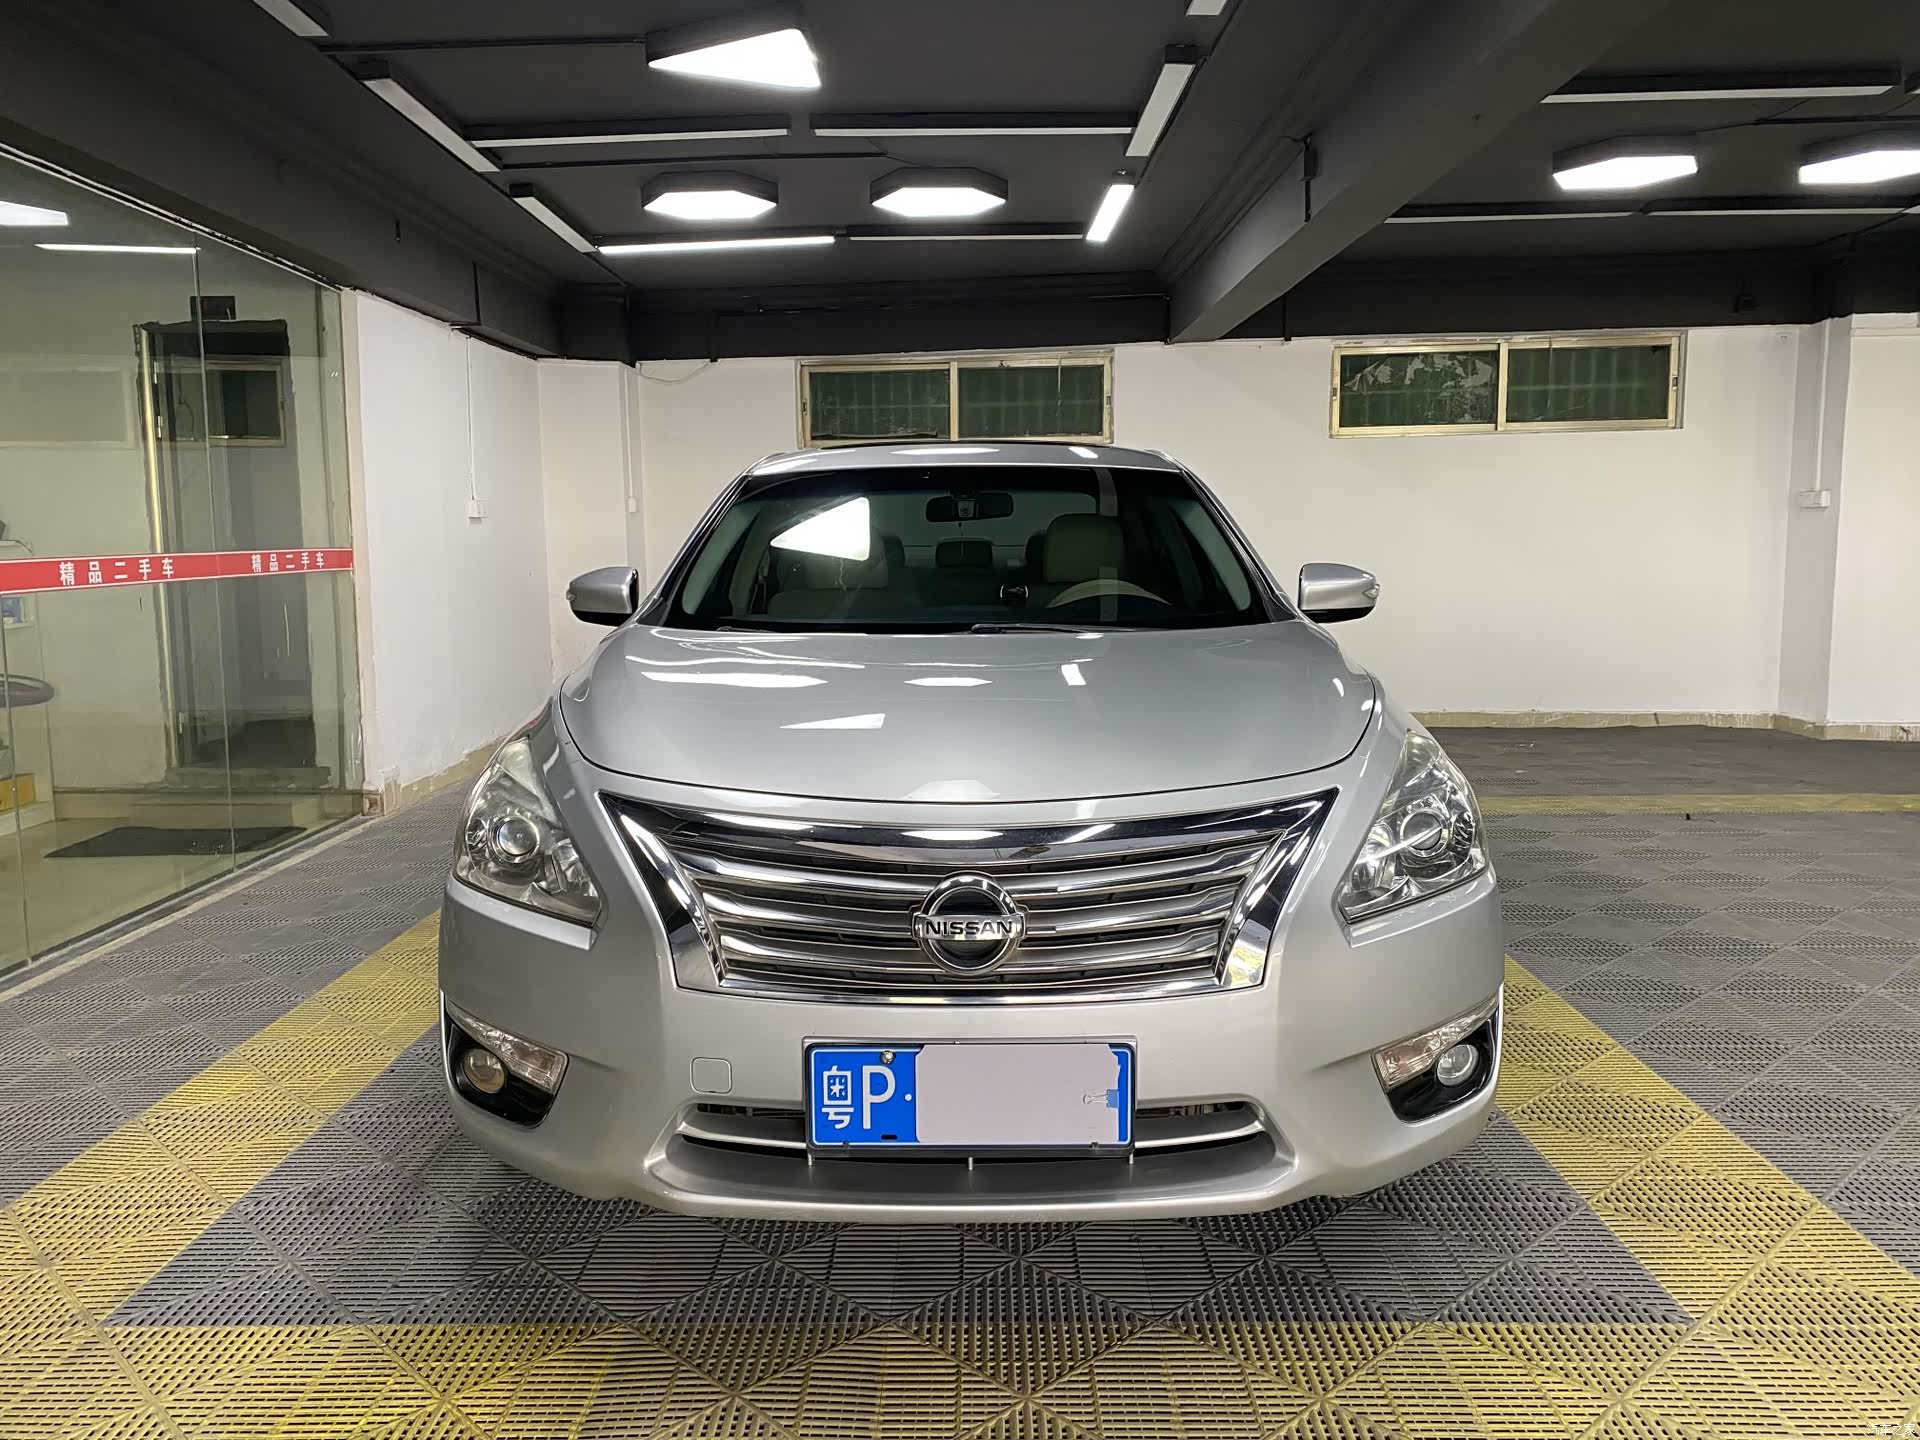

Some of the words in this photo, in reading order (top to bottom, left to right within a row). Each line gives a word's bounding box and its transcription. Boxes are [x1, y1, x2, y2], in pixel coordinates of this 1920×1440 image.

[59, 557, 175, 586] 精品二手车
[251, 551, 325, 573] 精品二手车
[925, 921, 1012, 935] NISSAN
